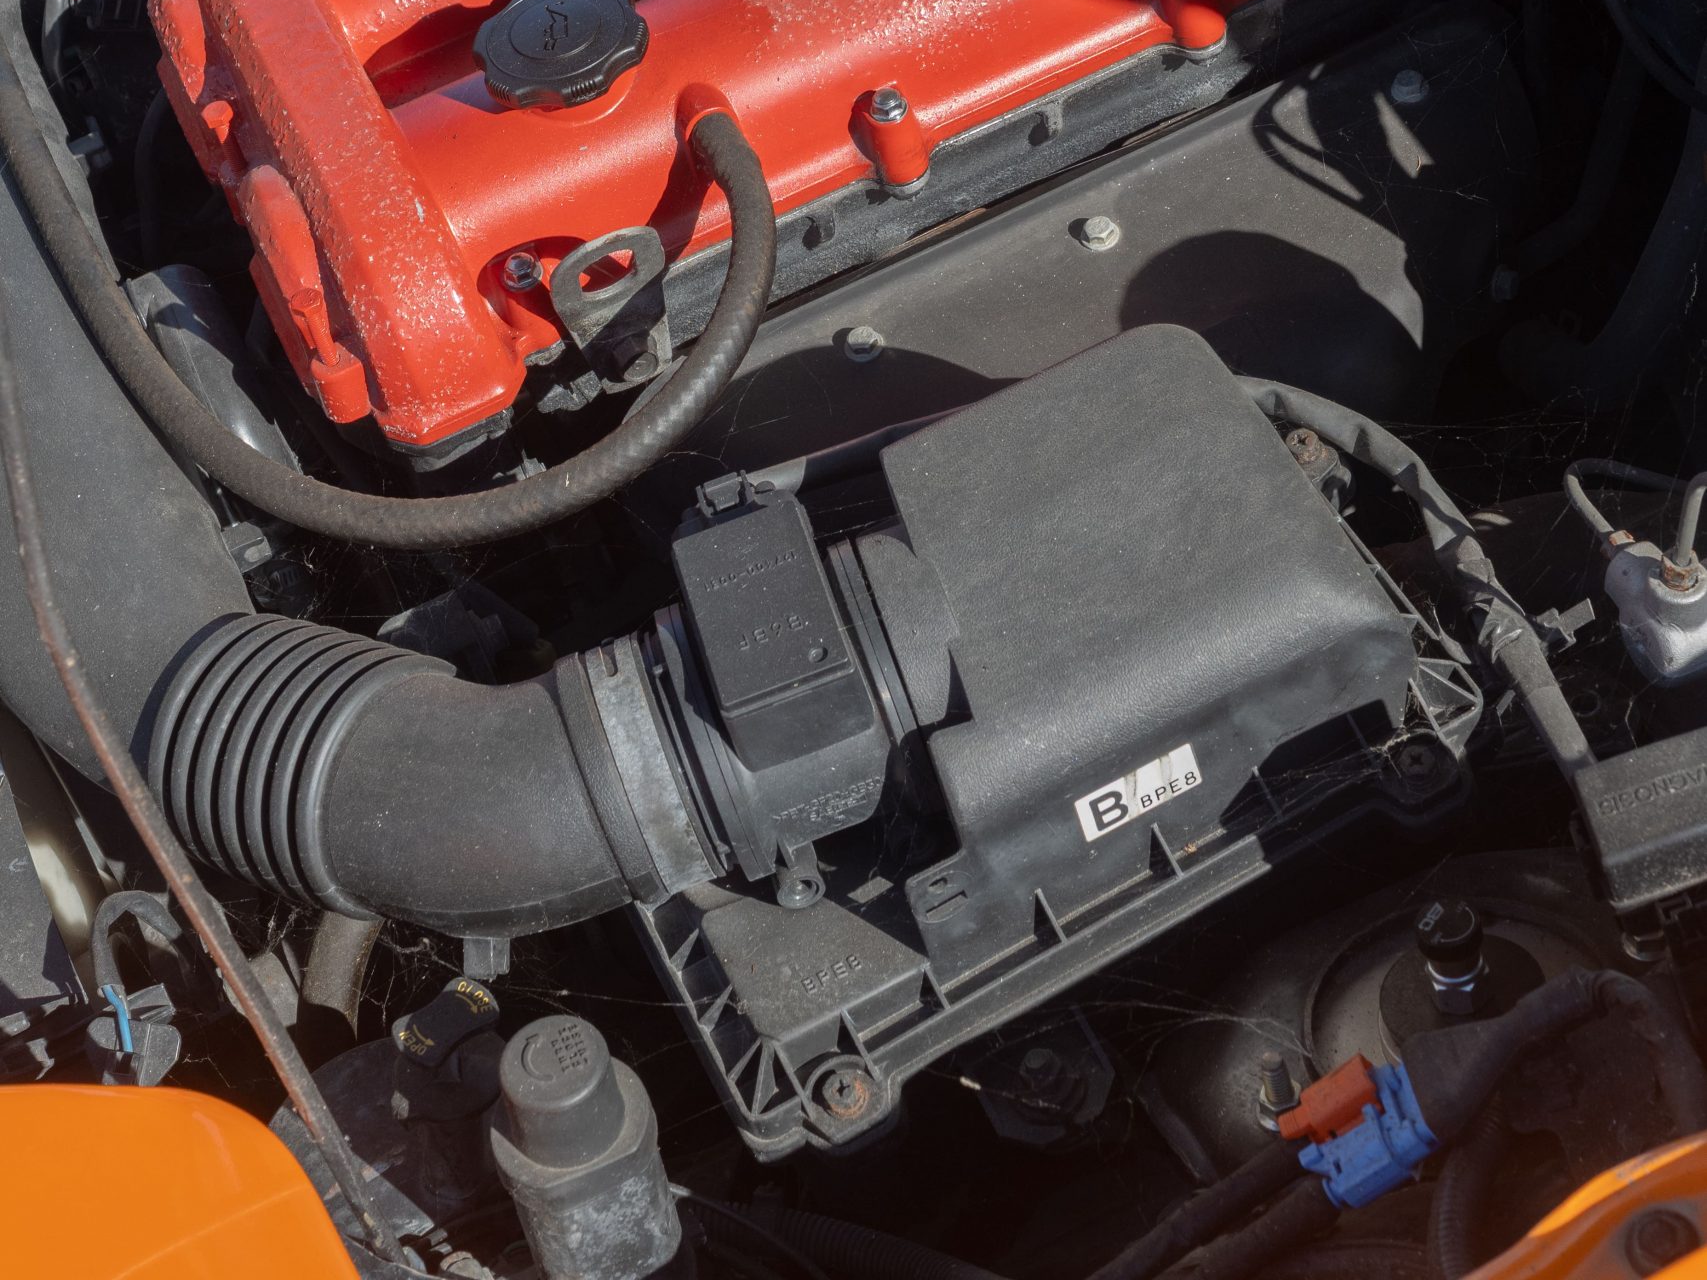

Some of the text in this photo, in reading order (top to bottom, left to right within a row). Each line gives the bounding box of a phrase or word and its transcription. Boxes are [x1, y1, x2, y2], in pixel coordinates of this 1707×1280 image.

[1088, 771, 1197, 832] B BPE8
[457, 981, 495, 1014] CLOSE
[398, 1031, 428, 1056] OPEN
